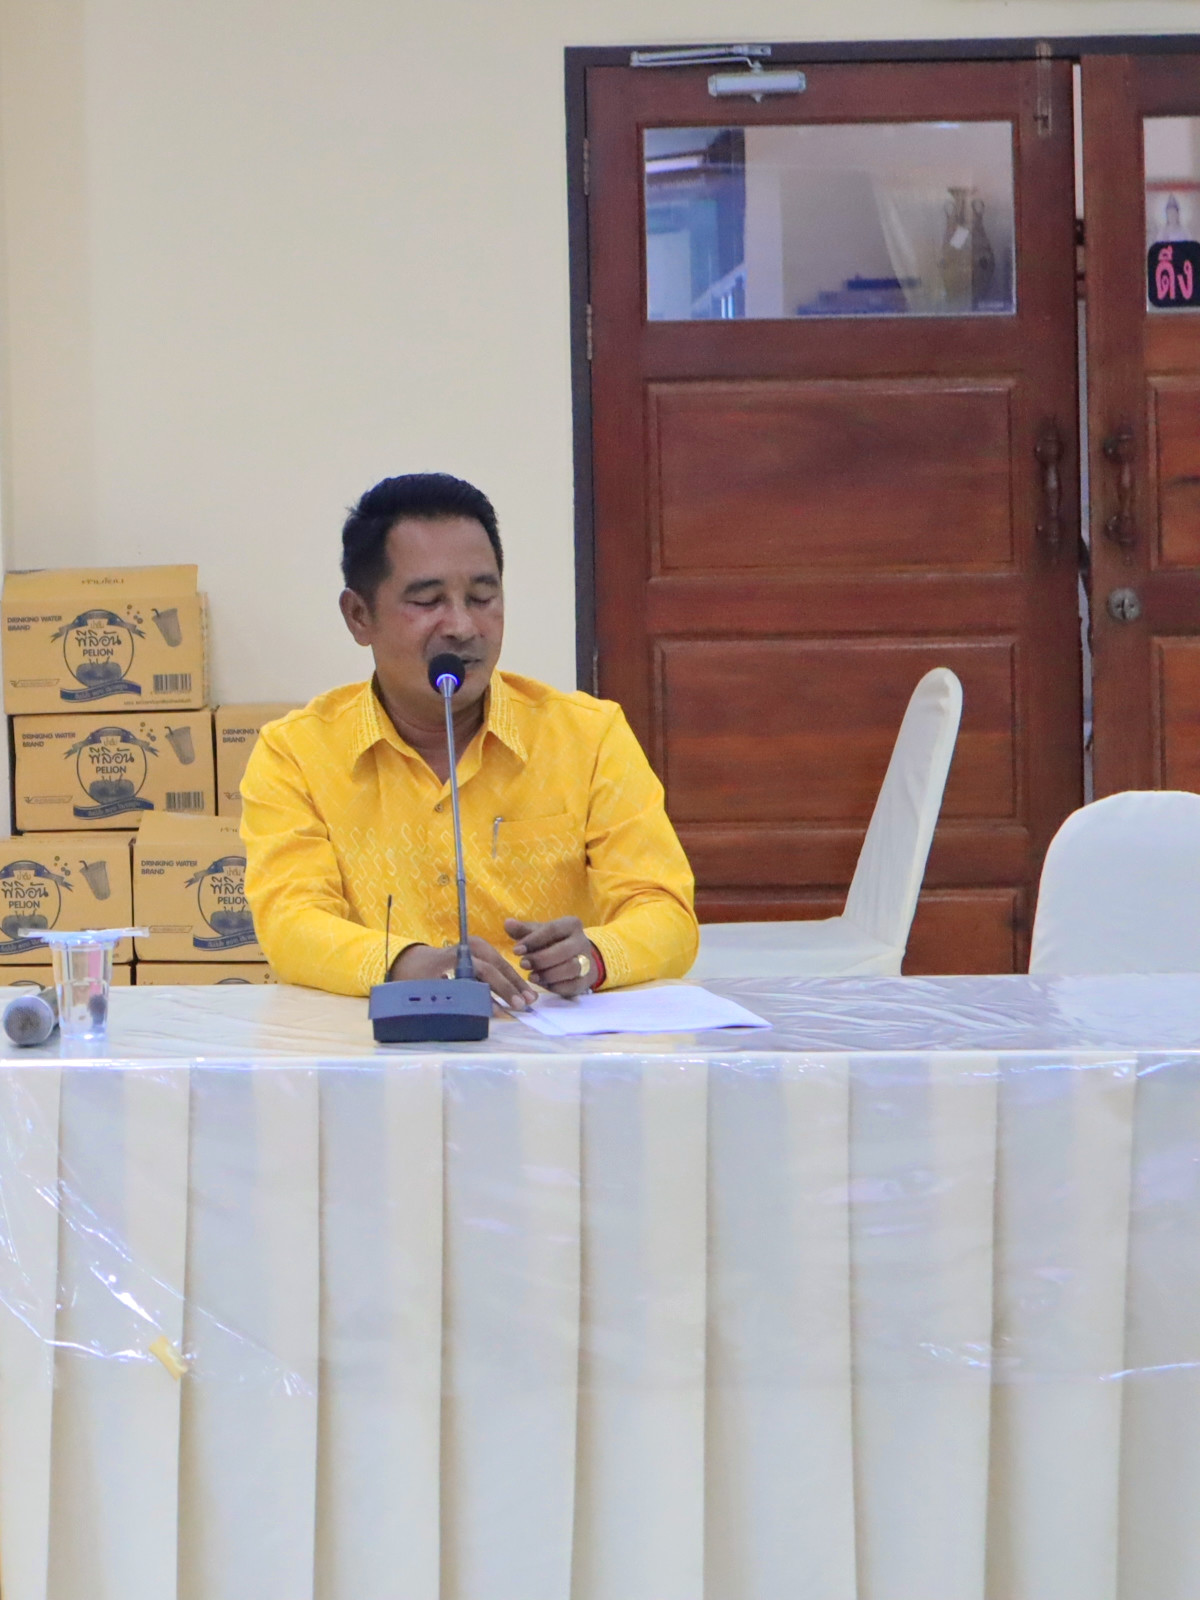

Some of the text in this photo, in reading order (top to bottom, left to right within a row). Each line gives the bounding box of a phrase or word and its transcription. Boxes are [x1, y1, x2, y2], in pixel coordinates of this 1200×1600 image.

[82, 648, 113, 657] PELION
[95, 765, 127, 774] PELION
[8, 900, 40, 909] PELION
